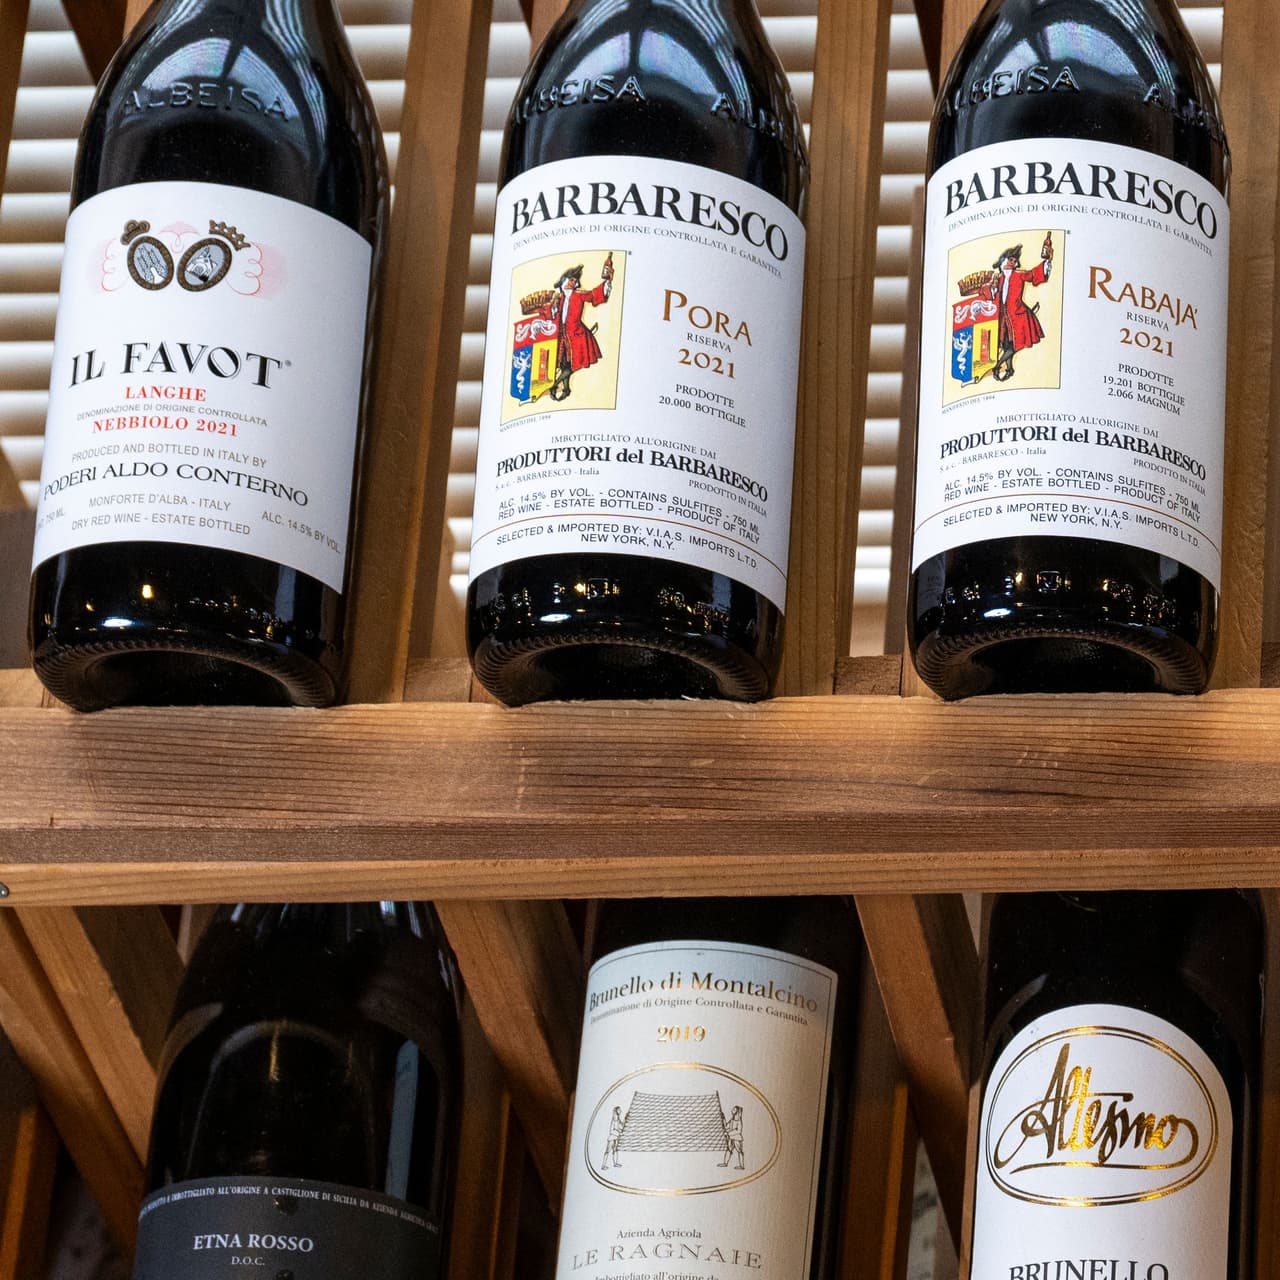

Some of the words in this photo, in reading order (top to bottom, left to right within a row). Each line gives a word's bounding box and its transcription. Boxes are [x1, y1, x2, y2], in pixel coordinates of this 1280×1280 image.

[944, 161, 1218, 241] BARBARESCO
[510, 181, 789, 262] BARBARESCO
[687, 332, 733, 353] RISERVA
[1119, 328, 1175, 359] 2021
[68, 353, 106, 389] IL
[120, 341, 283, 389] FAVOT
[678, 348, 737, 380] 2021
[125, 385, 207, 402] LANGHE
[92, 415, 189, 433] NEBBIOLO
[196, 419, 239, 437] 2021
[44, 467, 97, 501] PODERI
[102, 462, 168, 479] ALDO
[177, 463, 309, 507] CONTERNO
[495, 445, 612, 478] PRODUTTORI
[616, 446, 644, 464] del
[649, 454, 769, 503] BARBARESCO
[588, 973, 653, 1013] Brunello
[660, 971, 682, 991] di
[690, 971, 818, 1013] Montalcino
[656, 1024, 706, 1043] 2019
[193, 1233, 241, 1250] ETNA
[248, 1234, 314, 1253] ROSSO
[572, 1249, 599, 1271] LE
[609, 1243, 763, 1270] RAGNAIE
[231, 1255, 265, 1267] D.O.C.
